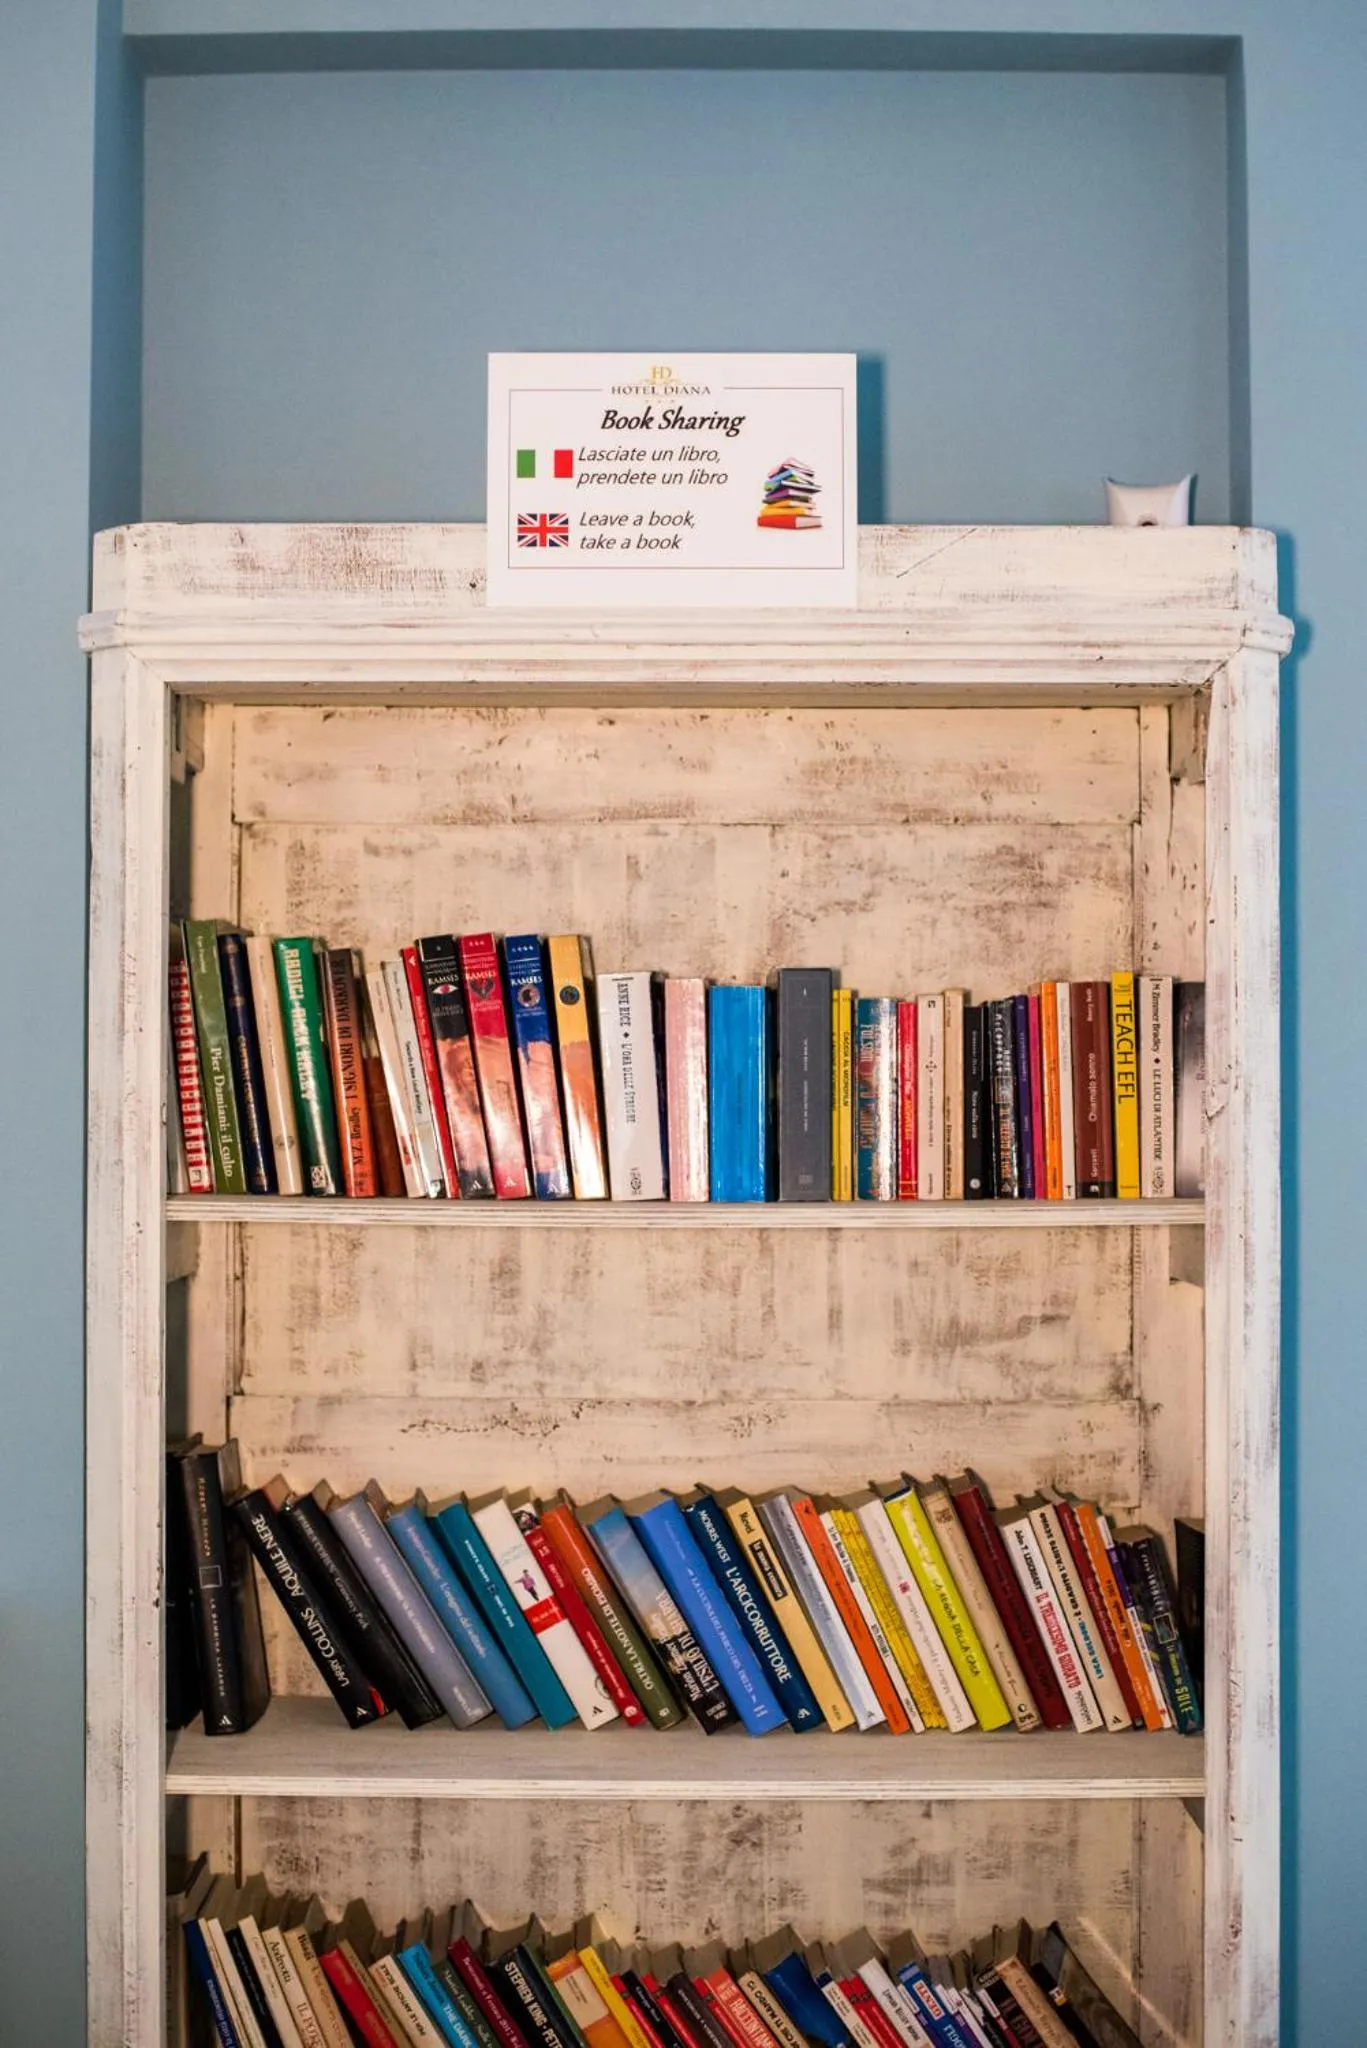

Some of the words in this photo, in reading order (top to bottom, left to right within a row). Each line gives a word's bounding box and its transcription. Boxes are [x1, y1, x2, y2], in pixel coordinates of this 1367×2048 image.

[611, 385, 657, 395] HOTEL
[664, 385, 711, 395] DIANA
[601, 405, 654, 430] Book
[658, 405, 746, 437] Sharing
[578, 446, 646, 462] Lasciate
[651, 450, 674, 462] un
[678, 446, 721, 463] libro,
[576, 469, 656, 489] prendete
[662, 473, 684, 484] un
[688, 469, 728, 485] libro
[579, 511, 629, 526] Leave
[633, 514, 644, 526] a
[648, 511, 695, 528] book,
[580, 534, 617, 549] take
[620, 538, 631, 549] a
[636, 534, 682, 549] book
[428, 974, 459, 985] RAMSES
[465, 970, 496, 980] RAMSES
[511, 975, 543, 987] RAMSES
[331, 959, 351, 1022] DARKOVER
[616, 982, 630, 1006] ANNE
[617, 1006, 632, 1027] RICE
[1151, 991, 1159, 1021] Zimmer
[338, 1026, 352, 1039] DI
[1115, 1000, 1134, 1064] TEACH
[1150, 1023, 1161, 1052] Bradley
[208, 1045, 223, 1071] Pier
[339, 1042, 357, 1092] SIGNORI
[1117, 1071, 1134, 1104] EFL
[1152, 1068, 1160, 1079] LE
[1152, 1081, 1161, 1100] LUCI
[1153, 1103, 1161, 1112] DI
[346, 1106, 362, 1139] Bradley
[1152, 1114, 1162, 1160] ATLANTIDE
[220, 1133, 232, 1145] il
[220, 1146, 236, 1178] culto
[250, 1512, 278, 1550] NERE
[696, 1507, 721, 1542] MORRIS
[712, 1540, 731, 1564] WEST
[1013, 1528, 1026, 1545] John
[268, 1548, 306, 1600] AQUILE
[1059, 1571, 1078, 1609] GRADITO
[600, 1603, 614, 1618] DI
[721, 1565, 796, 1684] L'ARCICORRUTTORE
[299, 1604, 337, 1659] COLLINS
[607, 1615, 631, 1648] NOTTE
[676, 1631, 696, 1649] DI
[623, 1644, 638, 1661] LA
[659, 1639, 689, 1675] Zimmer
[950, 1622, 971, 1652] DELLA
[963, 1652, 982, 1678] CASA
[326, 1657, 350, 1687] LARRY
[632, 1660, 655, 1691] OLTRE
[683, 1644, 722, 1693] L'ESILIO
[1056, 1652, 1081, 1689] GIURATO
[1090, 1656, 1104, 1679] LUCA
[677, 1669, 704, 1701] Marion
[1173, 1685, 1194, 1713] SOLE
[265, 1937, 296, 1984] Andreotti
[378, 1962, 396, 1985] SCALE
[391, 1984, 413, 2014] ANTICHE
[499, 1960, 537, 2005] STEPHEN
[524, 2000, 549, 2027] KING
[752, 1988, 778, 2020] MANDO
[409, 2012, 419, 2023] LE
[414, 2020, 427, 2036] PER
[440, 2003, 459, 2024] THE
